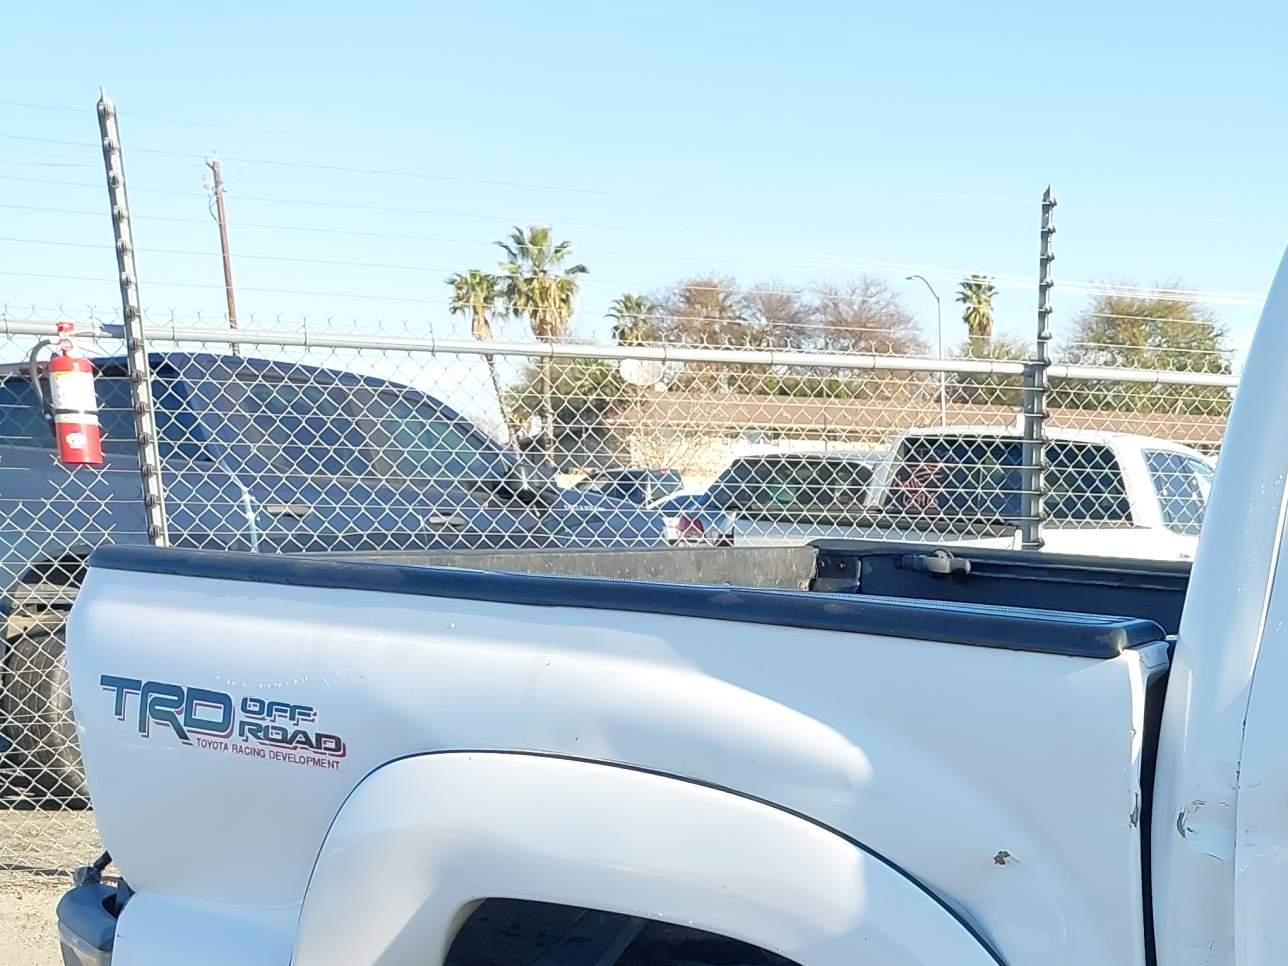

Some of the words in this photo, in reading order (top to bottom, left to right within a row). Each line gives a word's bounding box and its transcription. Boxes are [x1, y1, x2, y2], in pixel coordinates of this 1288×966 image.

[100, 674, 236, 745] TRD
[240, 697, 317, 726] OFF
[196, 737, 230, 753] TOYOTA
[231, 743, 266, 758] RACING
[268, 749, 341, 770] DEVELOPMENT
[238, 720, 346, 757] ROAD
